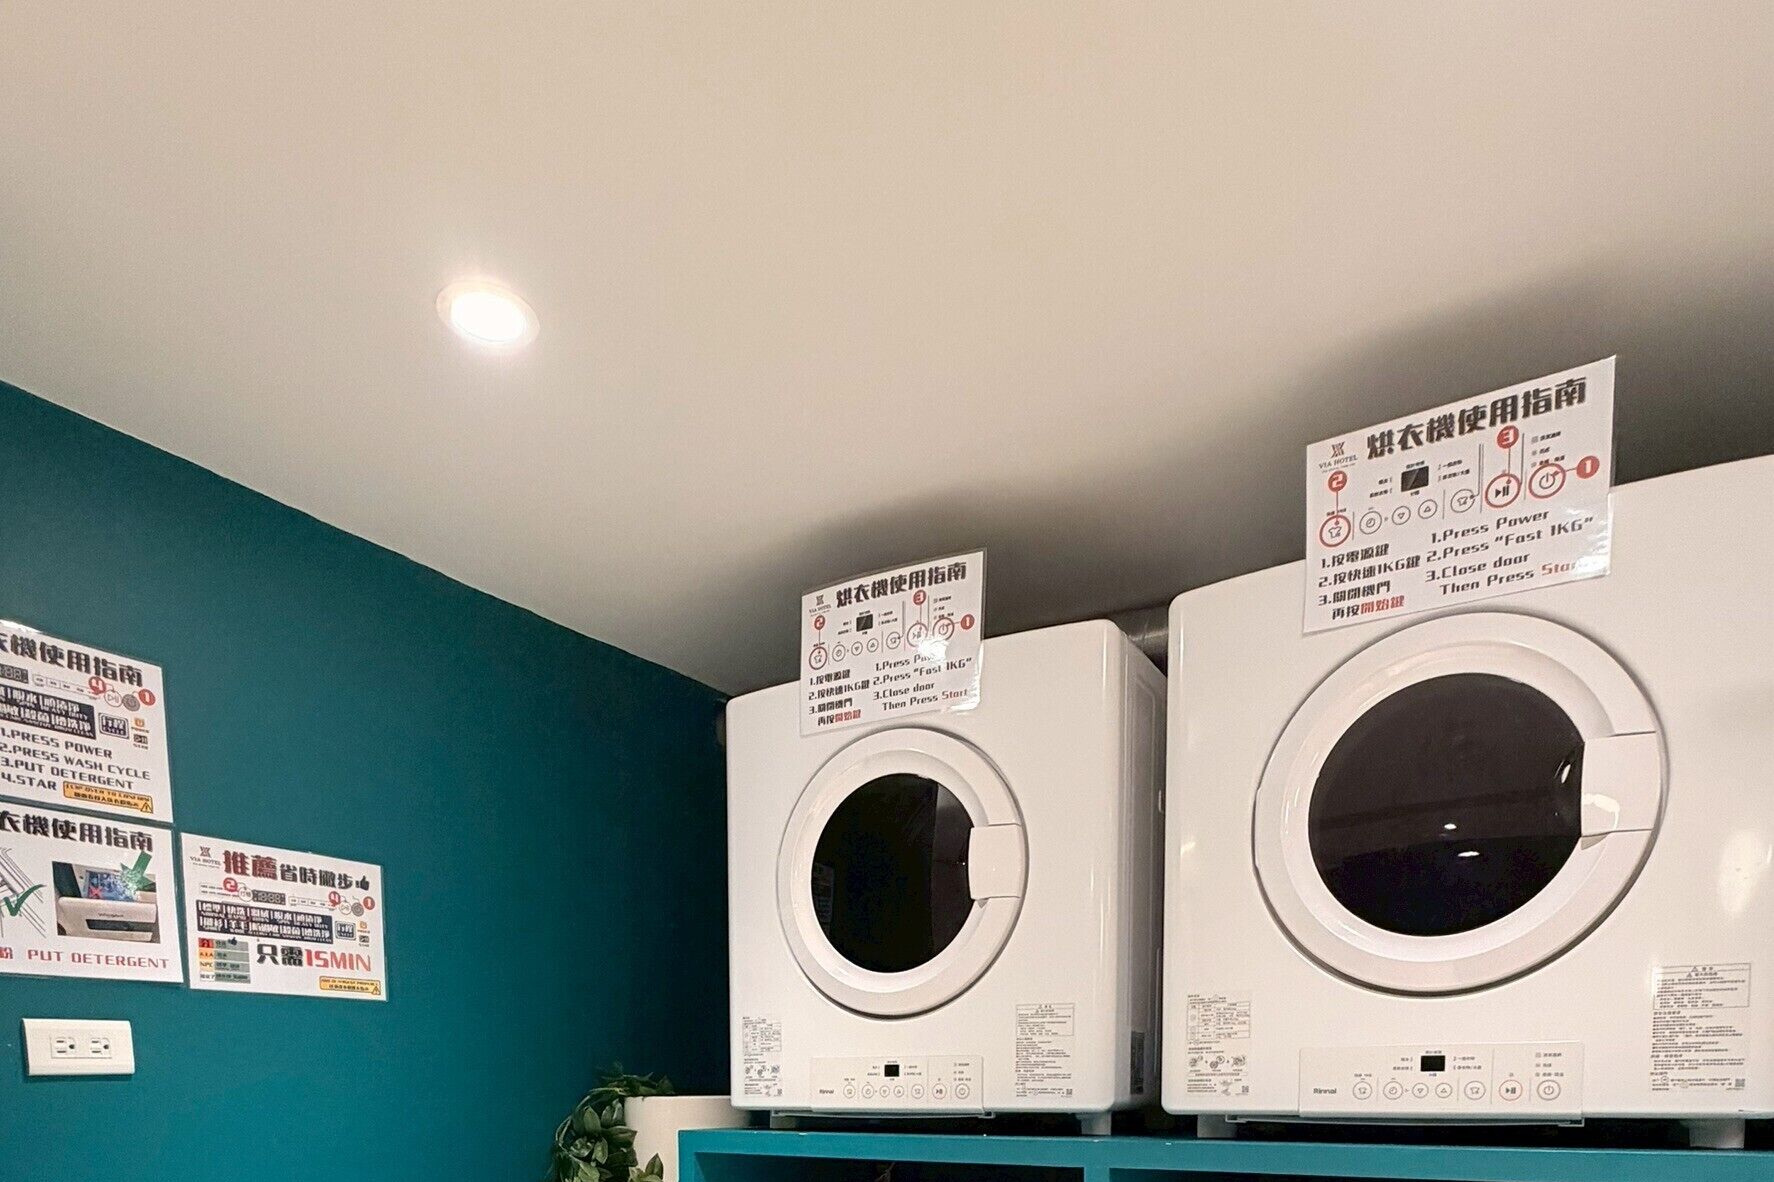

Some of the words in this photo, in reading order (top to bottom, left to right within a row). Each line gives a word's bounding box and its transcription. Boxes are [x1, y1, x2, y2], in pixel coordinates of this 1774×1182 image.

[1366, 377, 1587, 460] 烘衣機使用指南
[1334, 455, 1358, 465] HOTEL
[1432, 523, 1489, 543] 1.Press
[1496, 510, 1550, 530] Power
[1426, 542, 1489, 562] 2.Press
[1425, 561, 1487, 582] 3.Close
[1493, 553, 1531, 568] door
[1440, 581, 1480, 595] Then
[1487, 569, 1535, 587] Press
[1541, 561, 1577, 576] Sta
[836, 562, 967, 608] 烘衣機使用指南
[876, 658, 910, 671] 1.Press
[873, 673, 911, 686] 2.Press
[873, 688, 910, 700] 3.Close
[913, 682, 935, 692] door
[882, 701, 906, 711] Then
[910, 695, 938, 706] Press
[942, 689, 968, 700] Start
[0, 727, 60, 748] 1.PRESS
[65, 740, 112, 759] POWER
[0, 742, 59, 762] 2.PRESS
[64, 755, 103, 771] WASH
[108, 765, 151, 780] CYCLE
[0, 757, 45, 773] 3.PUT
[51, 766, 134, 790] DETERGENT
[1, 772, 57, 790] 4.STAR
[28, 949, 62, 961] PUT
[71, 952, 169, 969] DETERGENT
